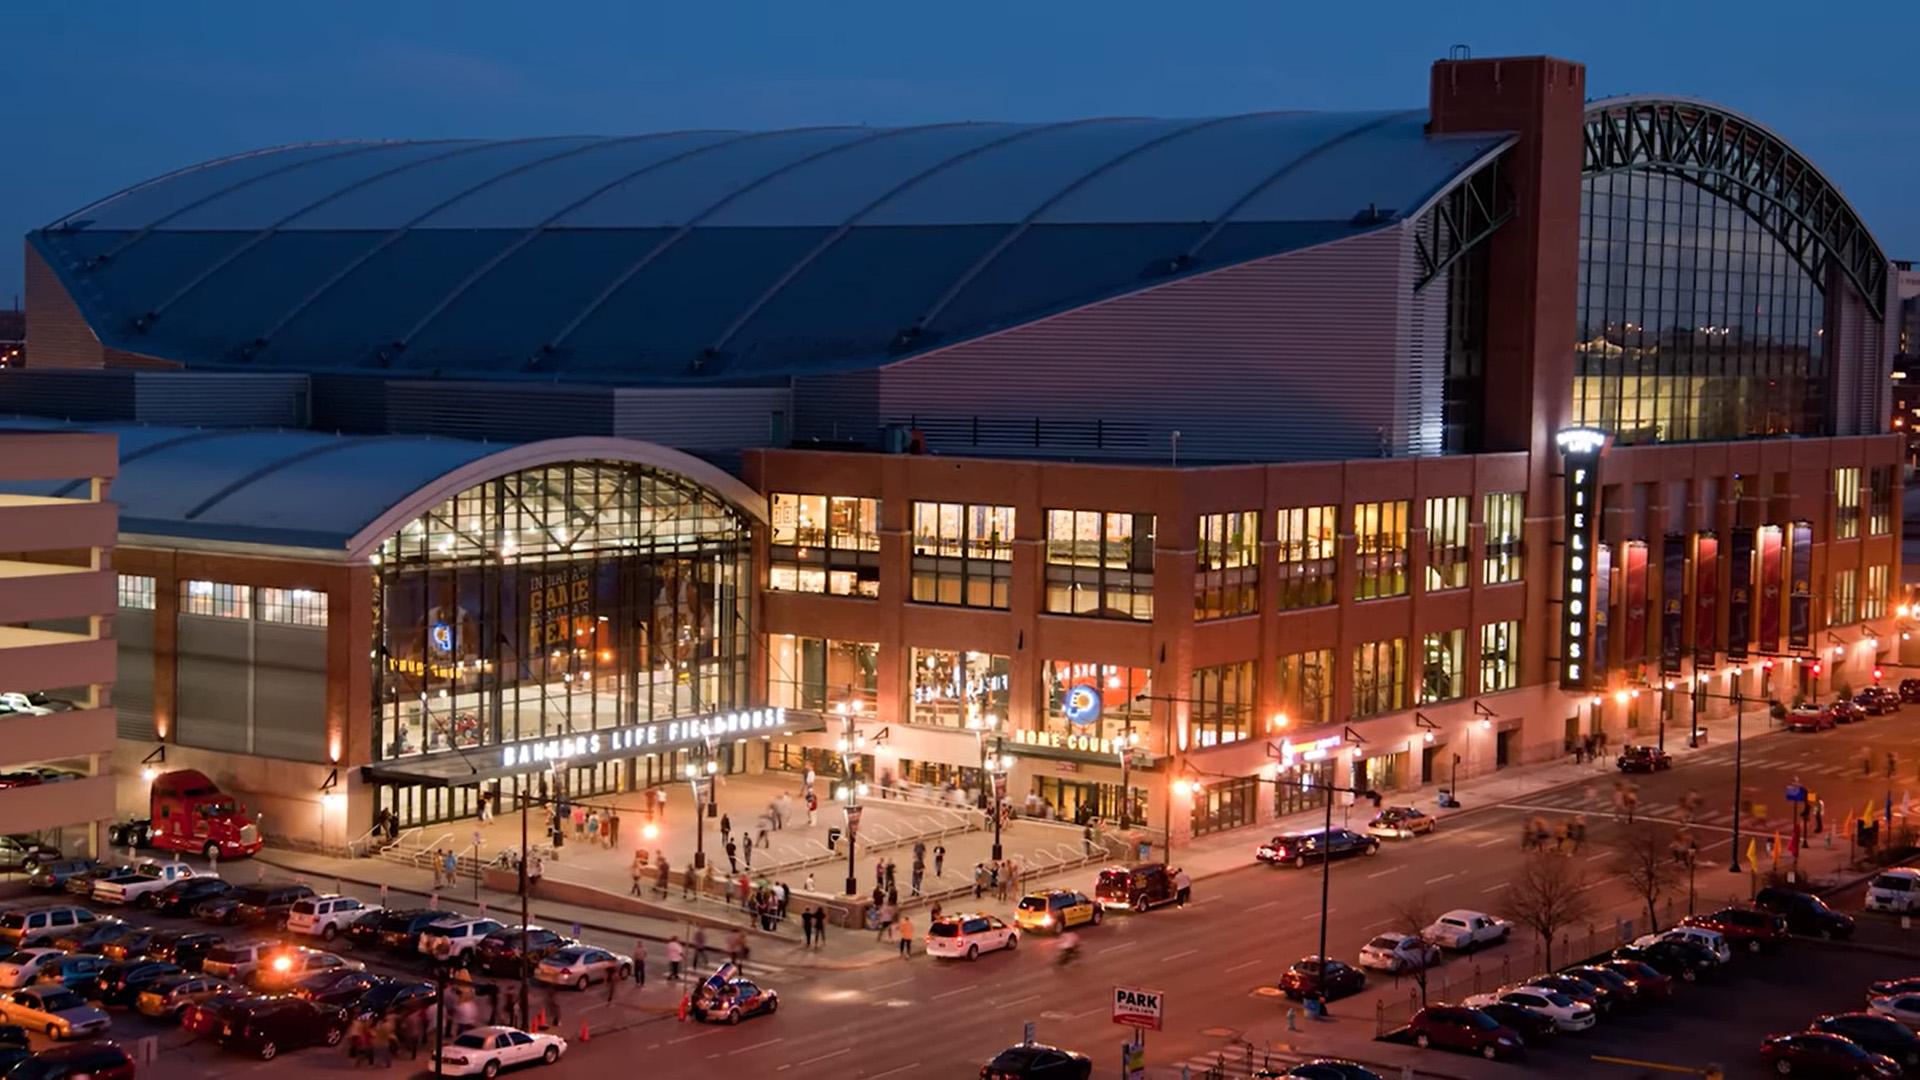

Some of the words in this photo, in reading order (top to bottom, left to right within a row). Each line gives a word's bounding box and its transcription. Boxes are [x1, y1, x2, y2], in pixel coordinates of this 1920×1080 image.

[1568, 469, 1586, 680] FIELDHOUSE
[529, 579, 589, 612] GAME
[503, 734, 601, 767] BANKERS
[611, 726, 658, 751] LIFE
[668, 707, 785, 741] FIELDHOUSE
[1016, 728, 1061, 748] HOME
[1117, 990, 1158, 1009] PARK
